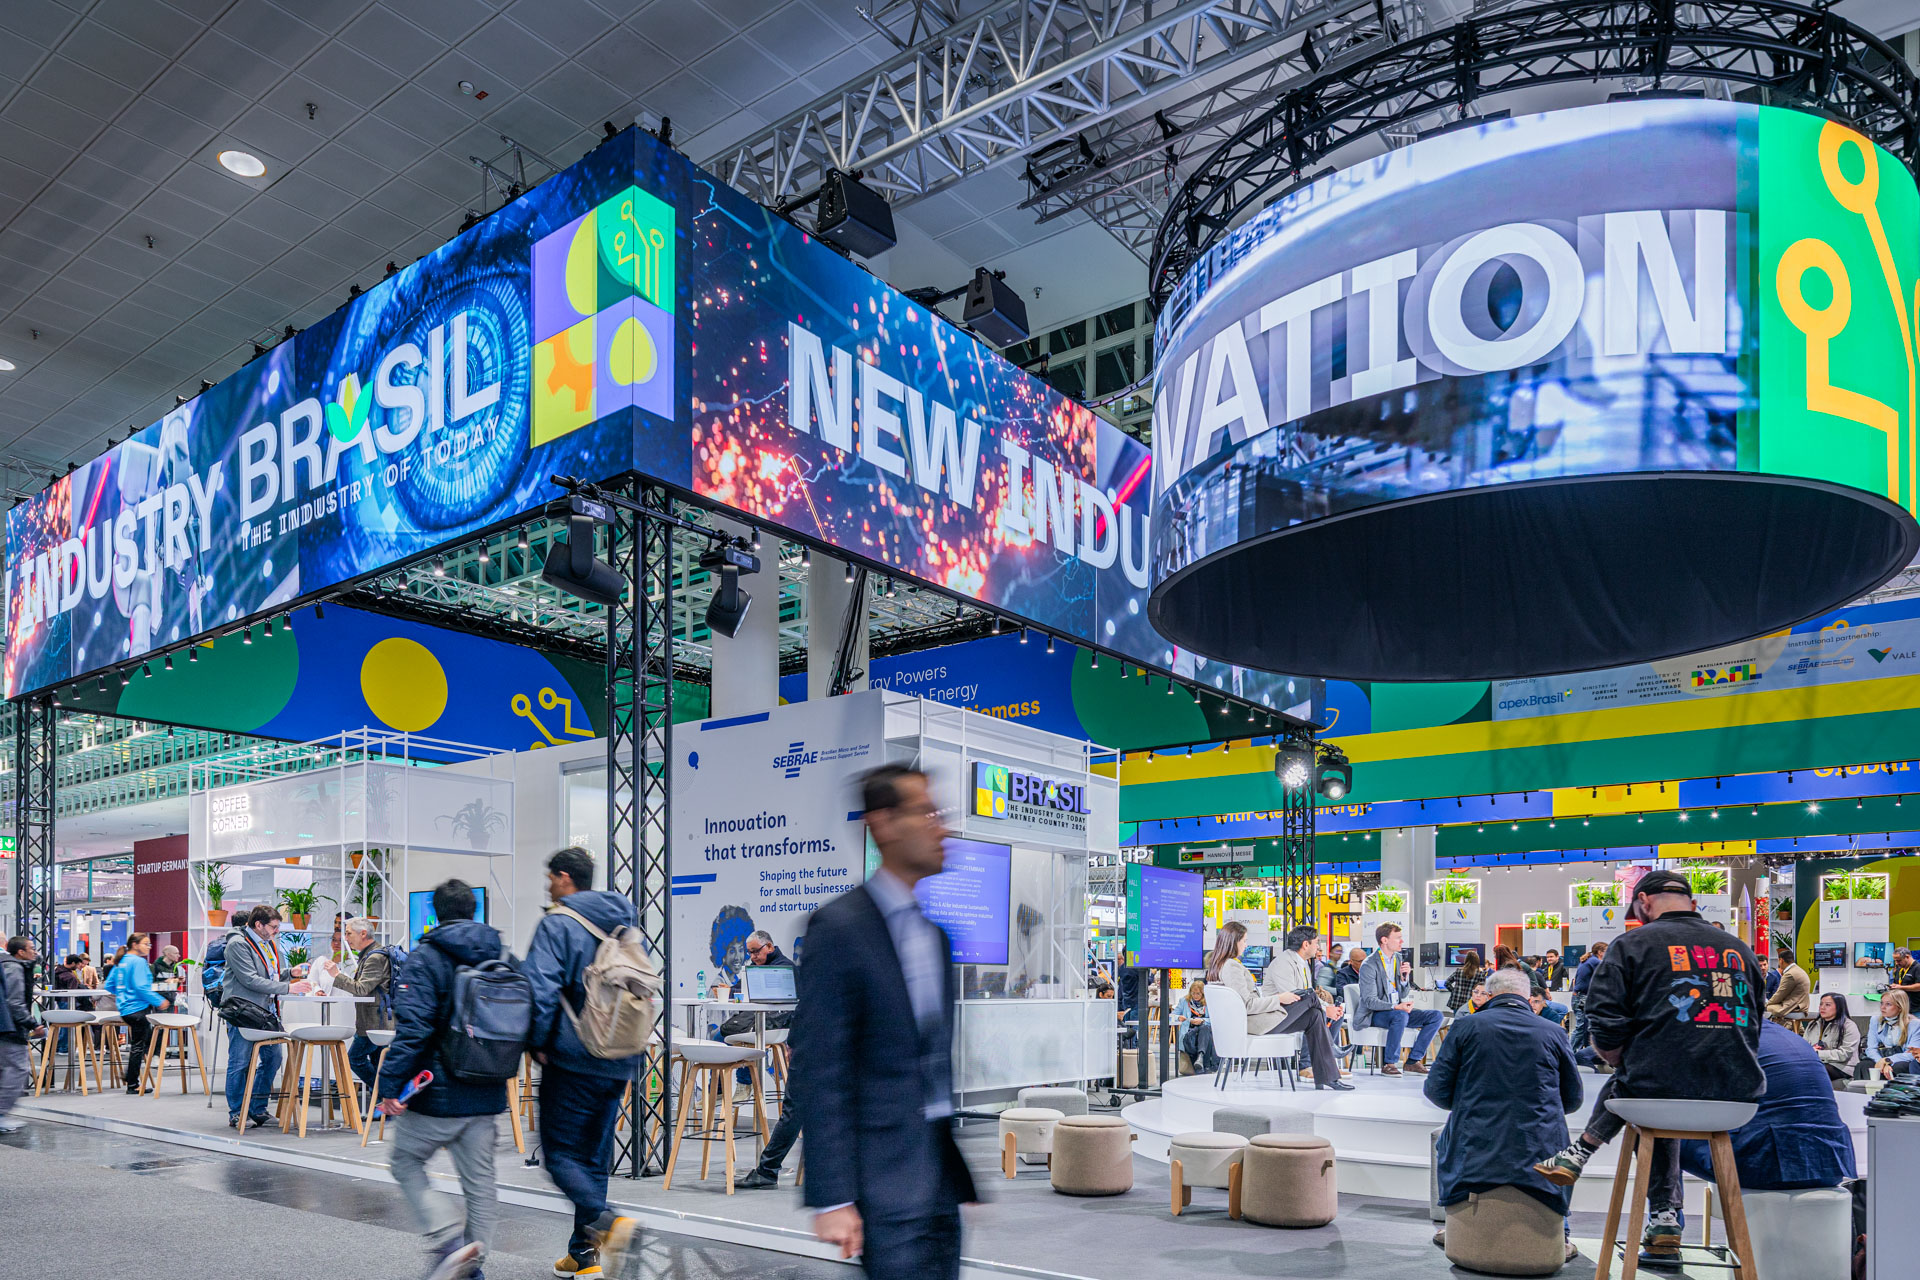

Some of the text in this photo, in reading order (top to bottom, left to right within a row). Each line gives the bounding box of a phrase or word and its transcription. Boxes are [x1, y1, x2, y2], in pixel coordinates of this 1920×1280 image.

[1151, 209, 1726, 497] VATION
[239, 311, 501, 523] BRASIL
[788, 321, 982, 510] NEW
[278, 473, 375, 537] INDUSTRY
[384, 457, 412, 488] OF
[420, 415, 500, 471] TODAY
[20, 460, 223, 632] INDUSTRY
[1892, 651, 1917, 660] VALE
[1691, 663, 1763, 687] BRASIL
[1788, 660, 1819, 671] SEBRAE
[895, 666, 947, 687] Powers
[929, 683, 979, 702] Energy
[1498, 691, 1564, 711] apexBrasil
[964, 700, 1041, 720] iomass
[773, 751, 819, 769] SEBRAE
[1010, 772, 1091, 815] BRASIL
[212, 795, 247, 813] COFFEE
[212, 815, 249, 833] CORNER
[705, 811, 787, 835] Innovation
[1022, 805, 1054, 818] INDUSTRY
[1056, 812, 1064, 820] OF
[1067, 814, 1086, 824] TODAY
[1038, 818, 1069, 829] COUNTRY
[1071, 823, 1086, 832] 2026
[704, 837, 836, 862] that transforms.
[136, 858, 189, 875] STARTUP GERMANY
[759, 866, 848, 884] Shaping the future
[759, 882, 855, 897] for small businesses
[1325, 882, 1351, 897] UP
[759, 902, 777, 913] and
